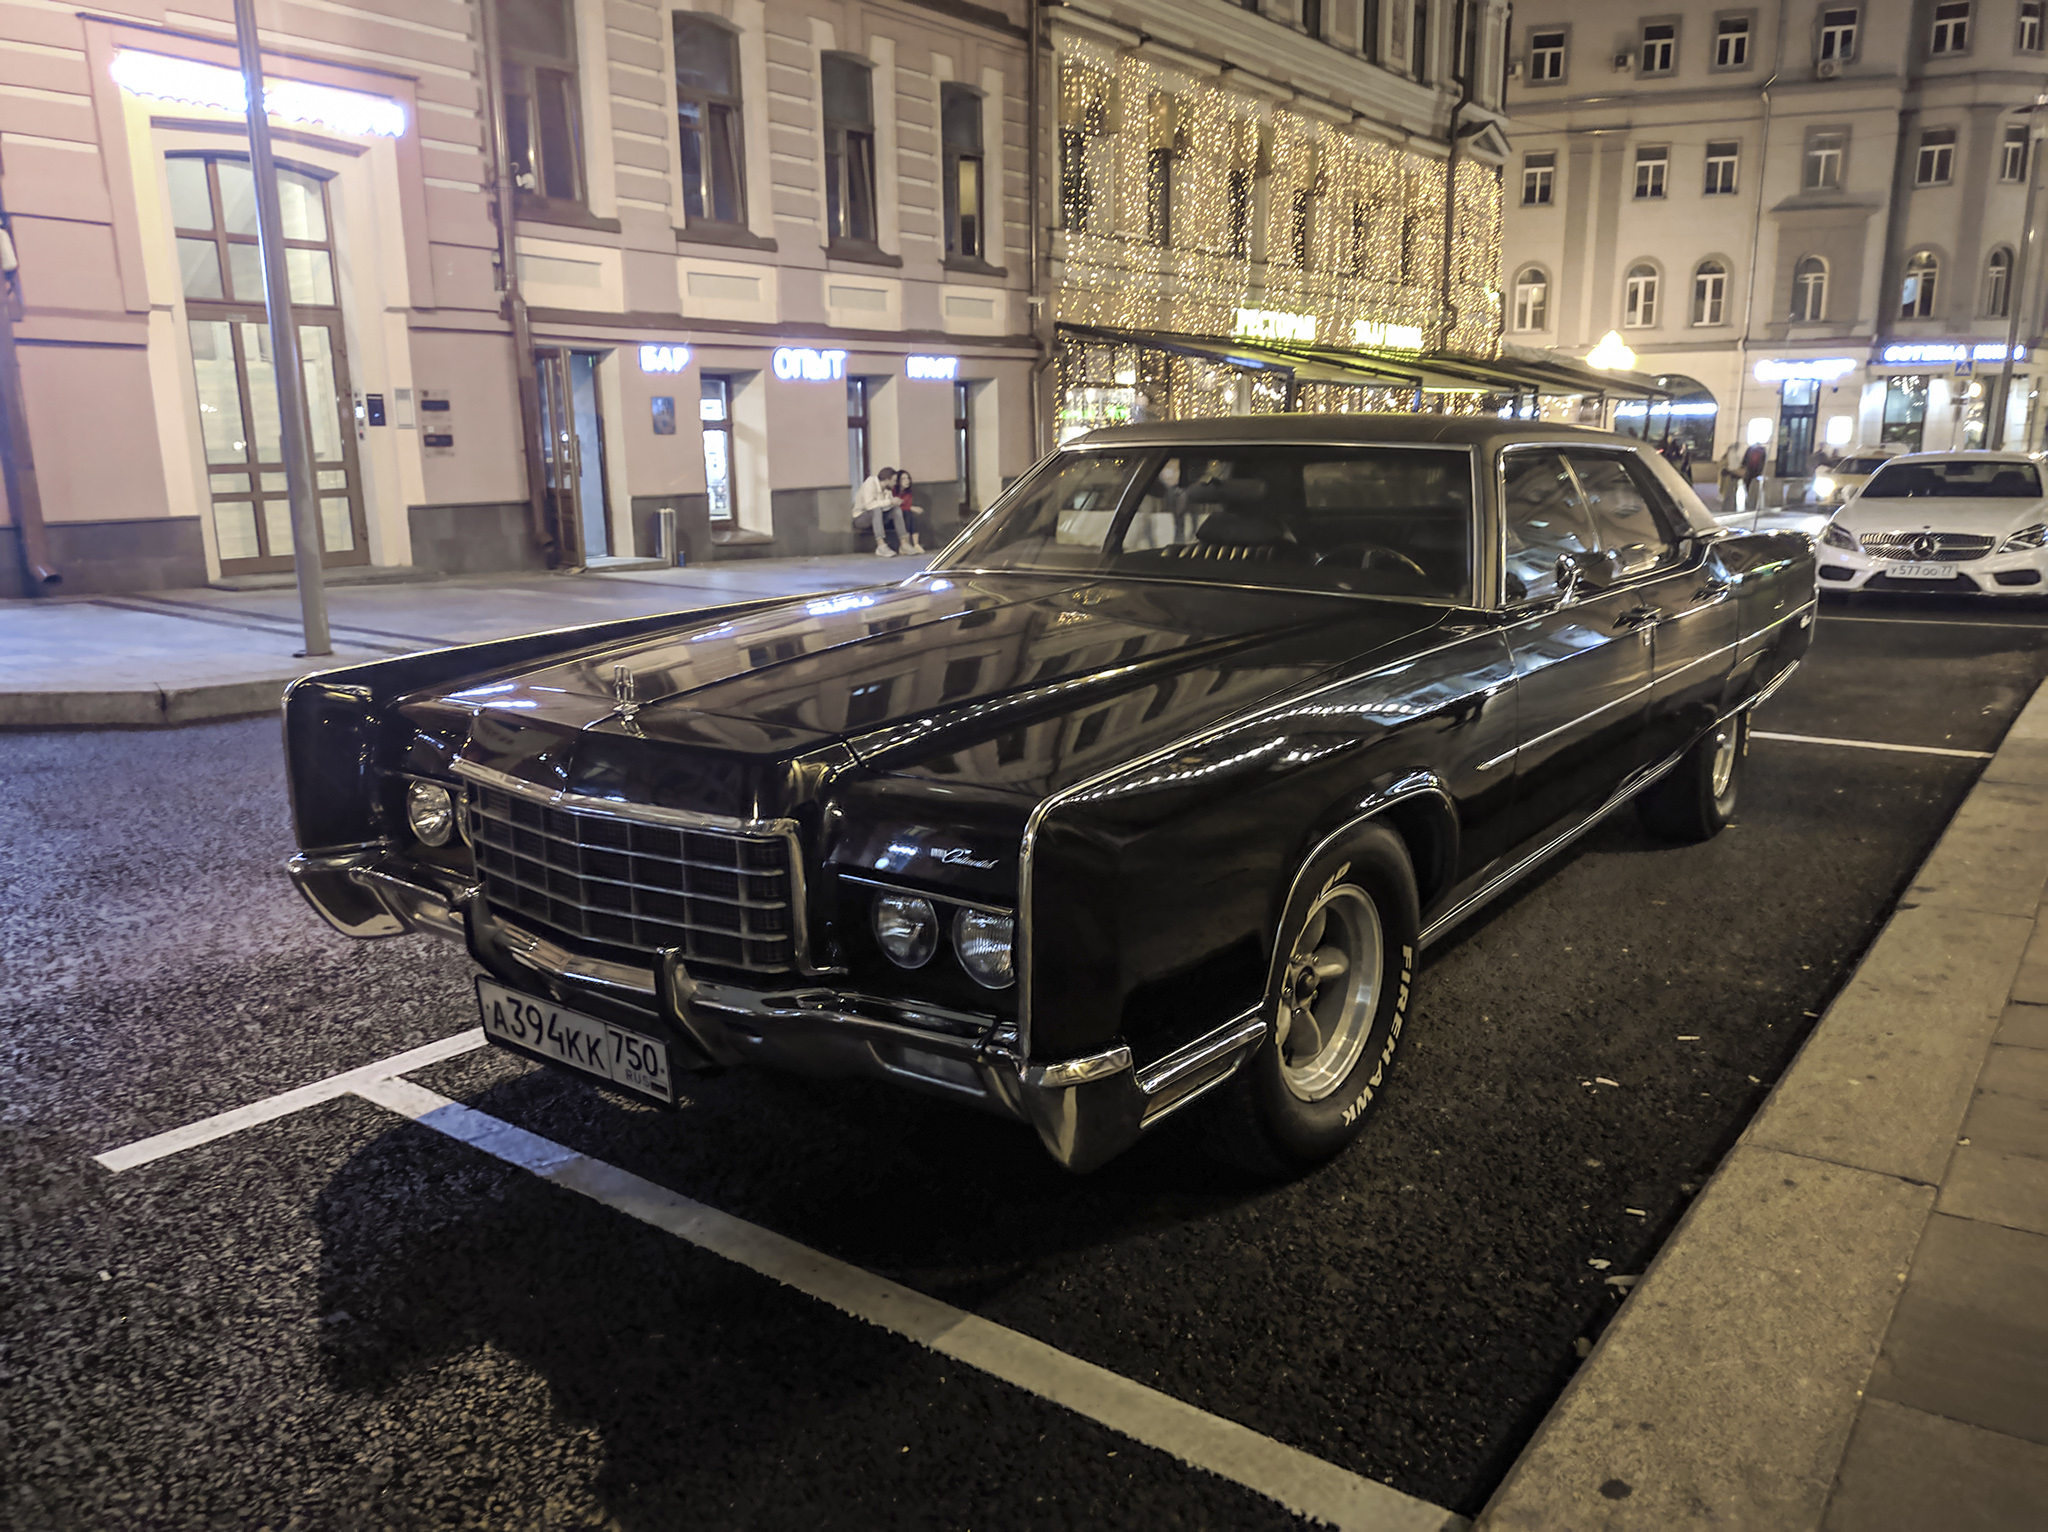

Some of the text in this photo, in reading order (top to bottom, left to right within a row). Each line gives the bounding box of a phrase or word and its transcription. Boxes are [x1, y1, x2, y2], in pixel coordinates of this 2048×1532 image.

[640, 345, 689, 372] БАР
[773, 347, 846, 379] ОПЫТ
[493, 996, 658, 1076] А394КК 750
[1342, 944, 1413, 1126] FIREHAWK
[626, 1069, 650, 1088] RUS
